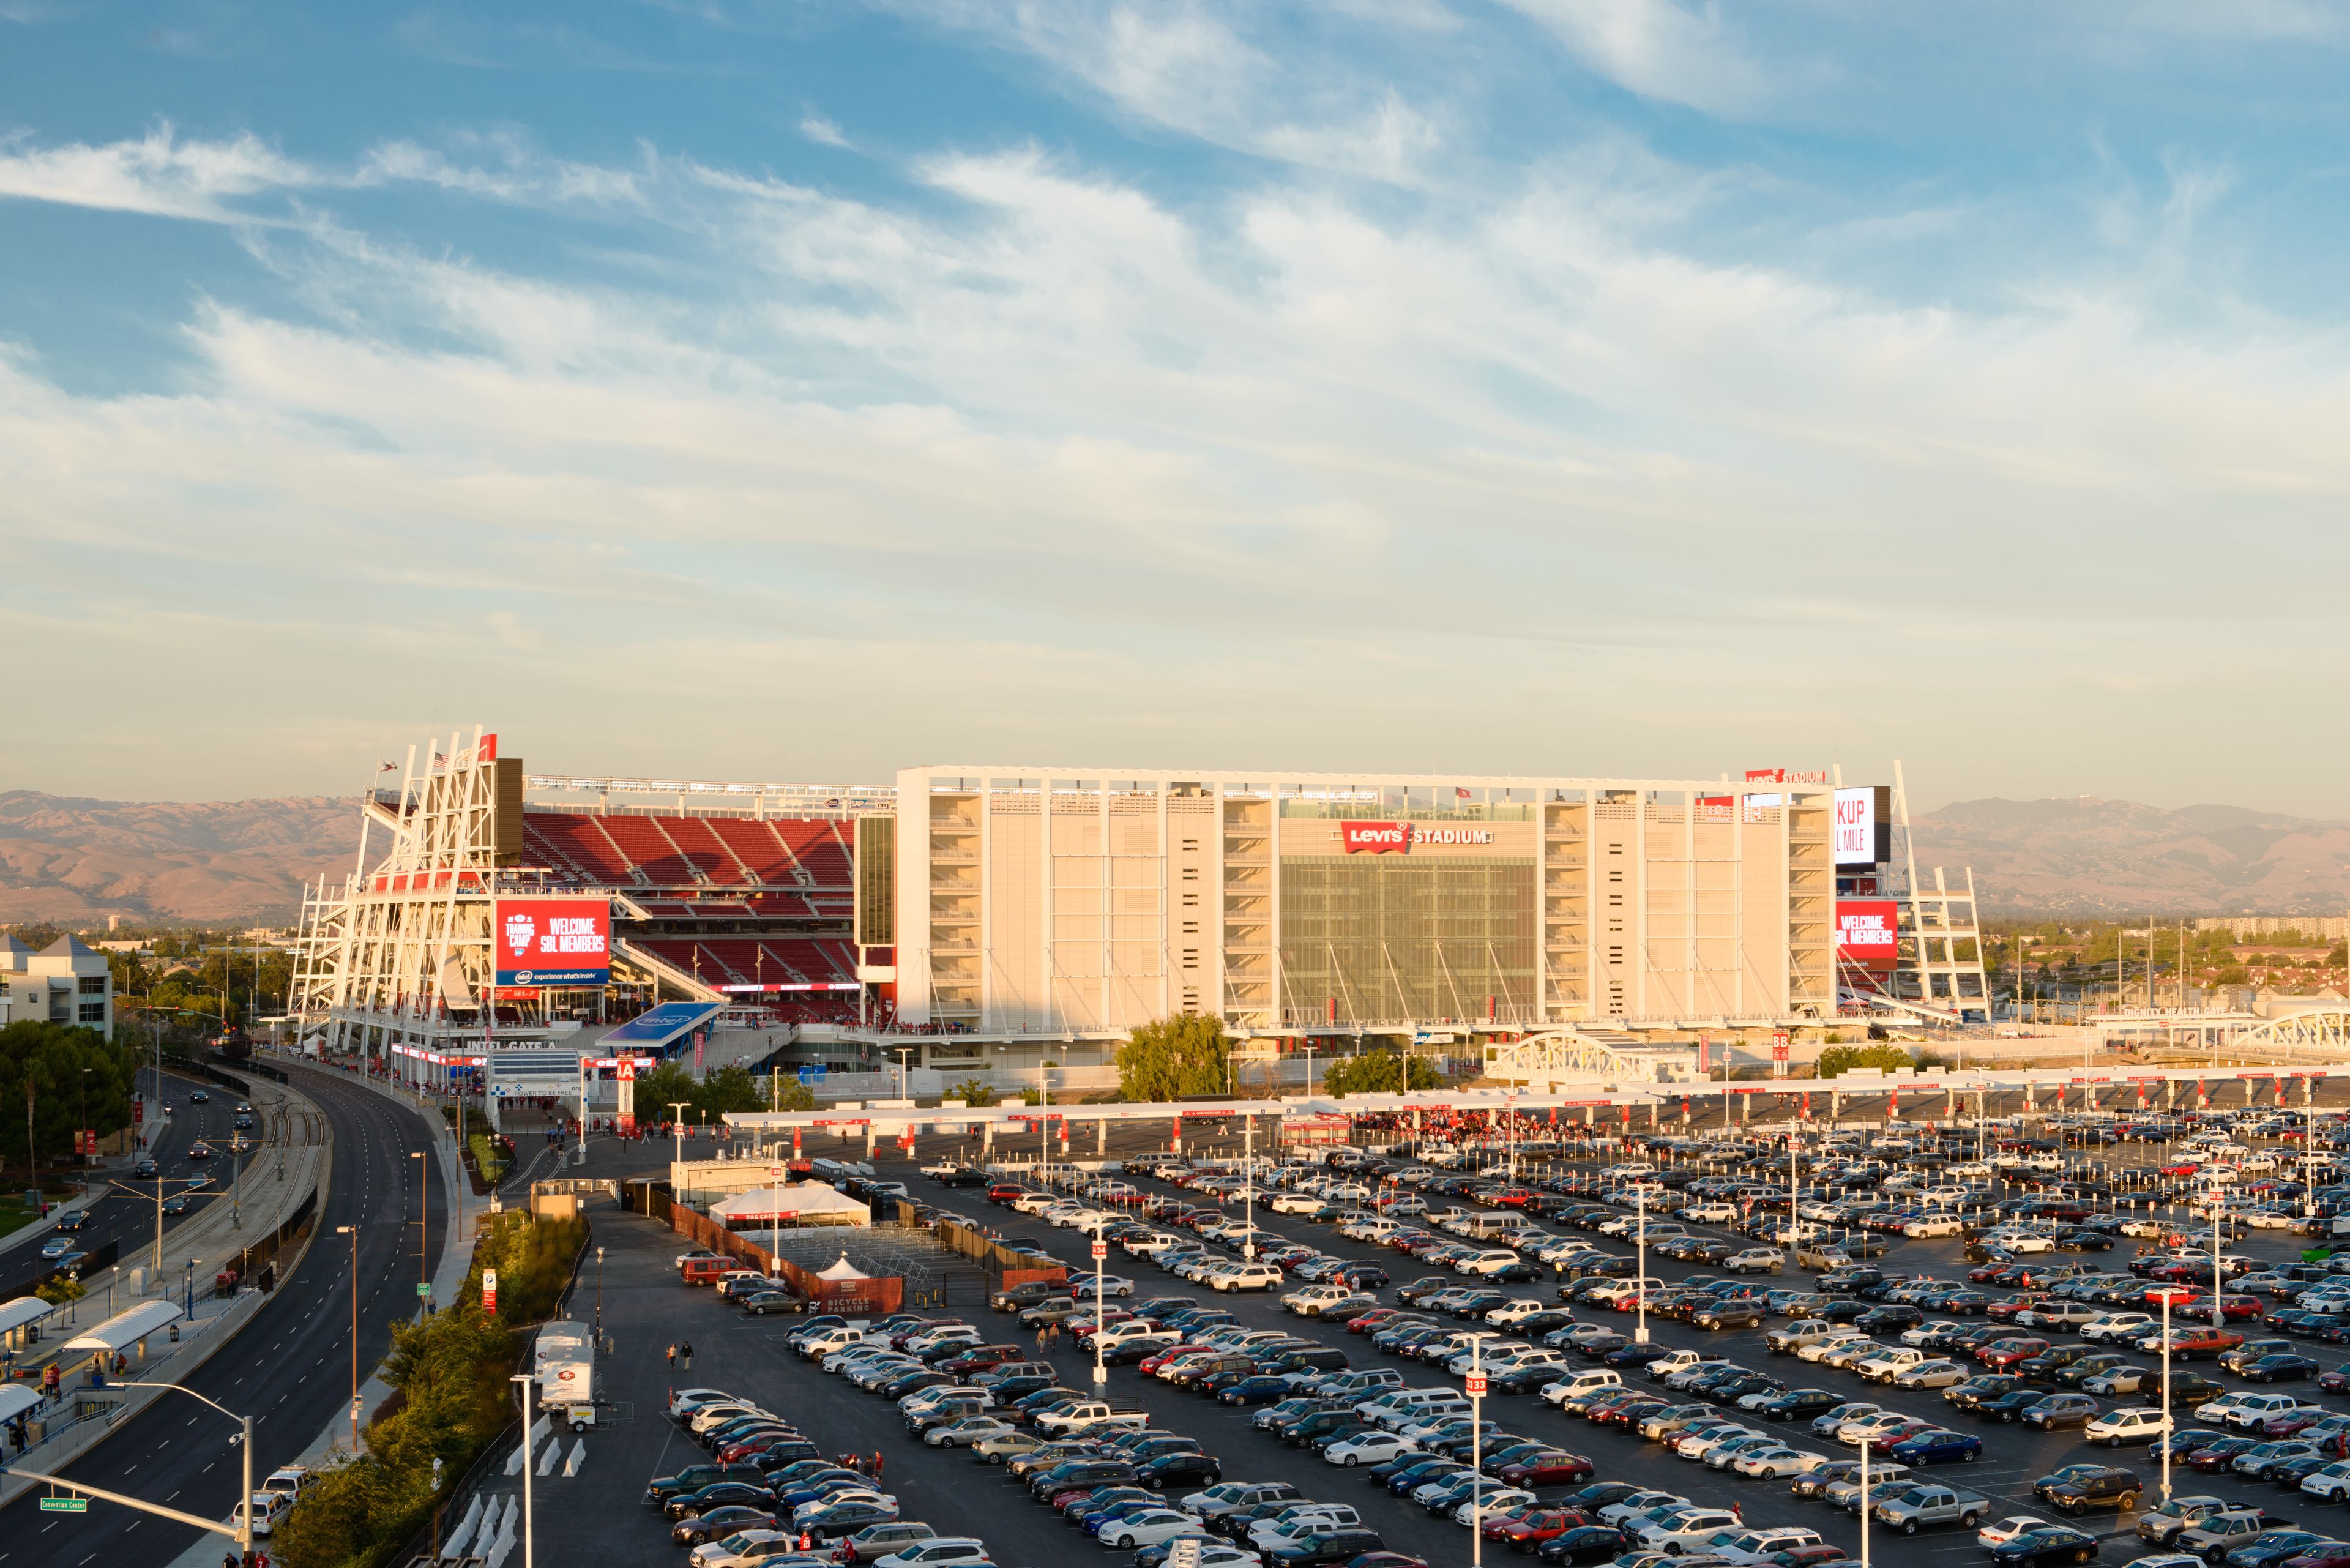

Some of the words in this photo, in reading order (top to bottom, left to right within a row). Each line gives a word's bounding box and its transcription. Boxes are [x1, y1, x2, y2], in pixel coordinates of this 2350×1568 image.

[1783, 771, 1824, 783] STADIUM
[1414, 830, 1487, 844] STADIUM
[550, 917, 595, 935] WELCOME
[1841, 916, 1884, 930] WELCOME
[505, 923, 534, 936] TRAINING
[509, 935, 531, 947] CAMP
[1851, 930, 1893, 944] MEMBERS
[540, 935, 558, 953] SBL
[560, 935, 605, 952] MEMBERS
[517, 972, 531, 980] intel
[534, 973, 562, 981] experience
[2124, 1009, 2162, 1017] DIGNITY
[2165, 1007, 2199, 1017] HEALTH
[2203, 1007, 2226, 1016] GATE
[467, 1040, 501, 1052] INTEL
[509, 1041, 542, 1050] GATE
[1773, 1036, 1780, 1048] B
[1781, 1036, 1788, 1048] B
[622, 1064, 635, 1078] A
[828, 1297, 870, 1306] BICYCLE
[828, 1305, 870, 1313] PARKING
[1474, 1380, 1485, 1389] 33
[42, 1500, 67, 1509] Convention
[803, 1539, 810, 1548] 21
